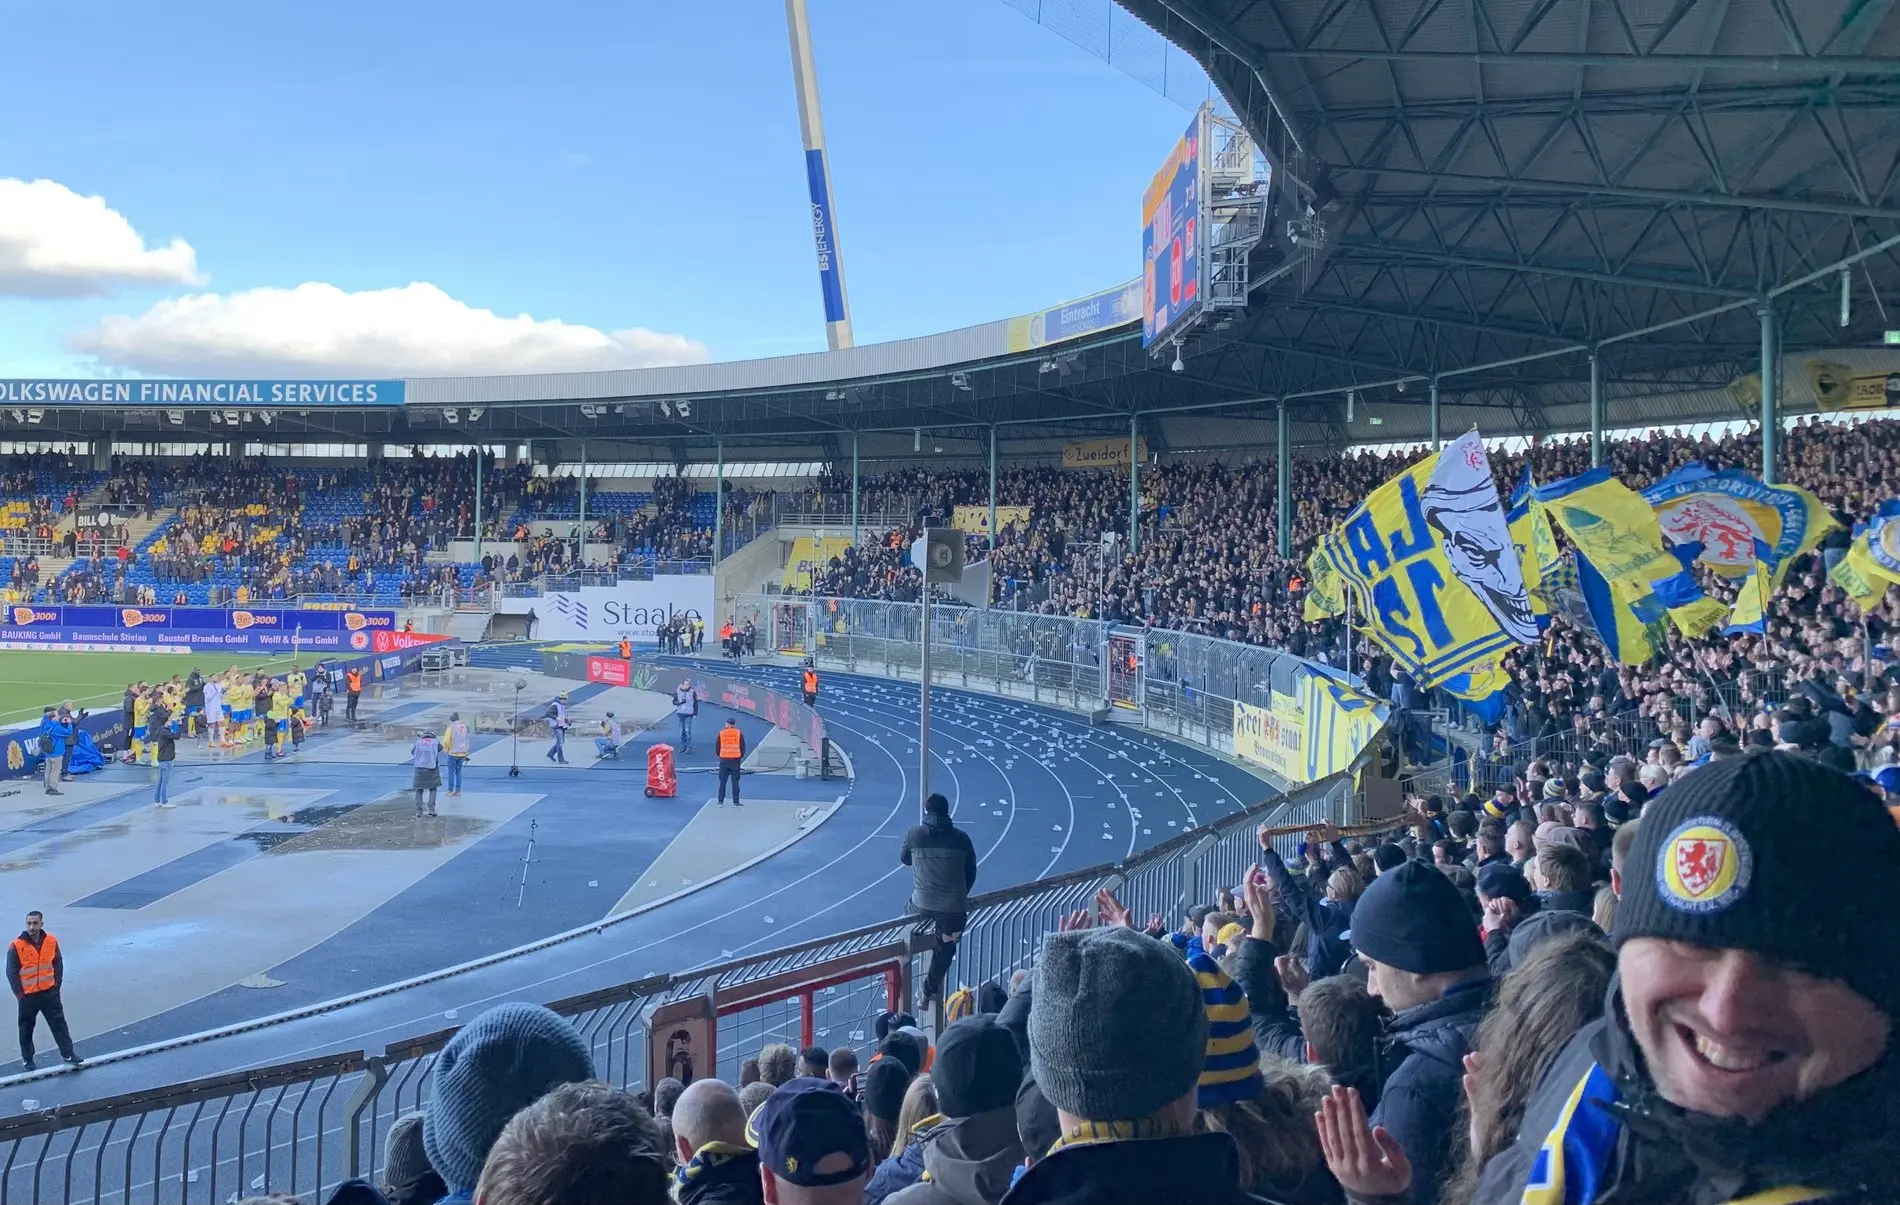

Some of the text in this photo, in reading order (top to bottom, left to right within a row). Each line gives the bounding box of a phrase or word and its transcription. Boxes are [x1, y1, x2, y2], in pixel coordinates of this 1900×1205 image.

[1060, 301, 1100, 325] Eintracht
[140, 383, 263, 402] FINANCIAL
[271, 383, 378, 402] SERVICES
[1075, 444, 1128, 462] Zweidorf
[77, 515, 97, 527] BILL
[603, 600, 701, 626] Staake
[1, 630, 62, 641] BAUKING GmbH
[72, 631, 119, 642] Baumschule
[617, 628, 659, 637] www.sta
[158, 633, 249, 644] Baustoff Brandes GmbH
[282, 635, 290, 644] &
[315, 636, 339, 645] GmbH
